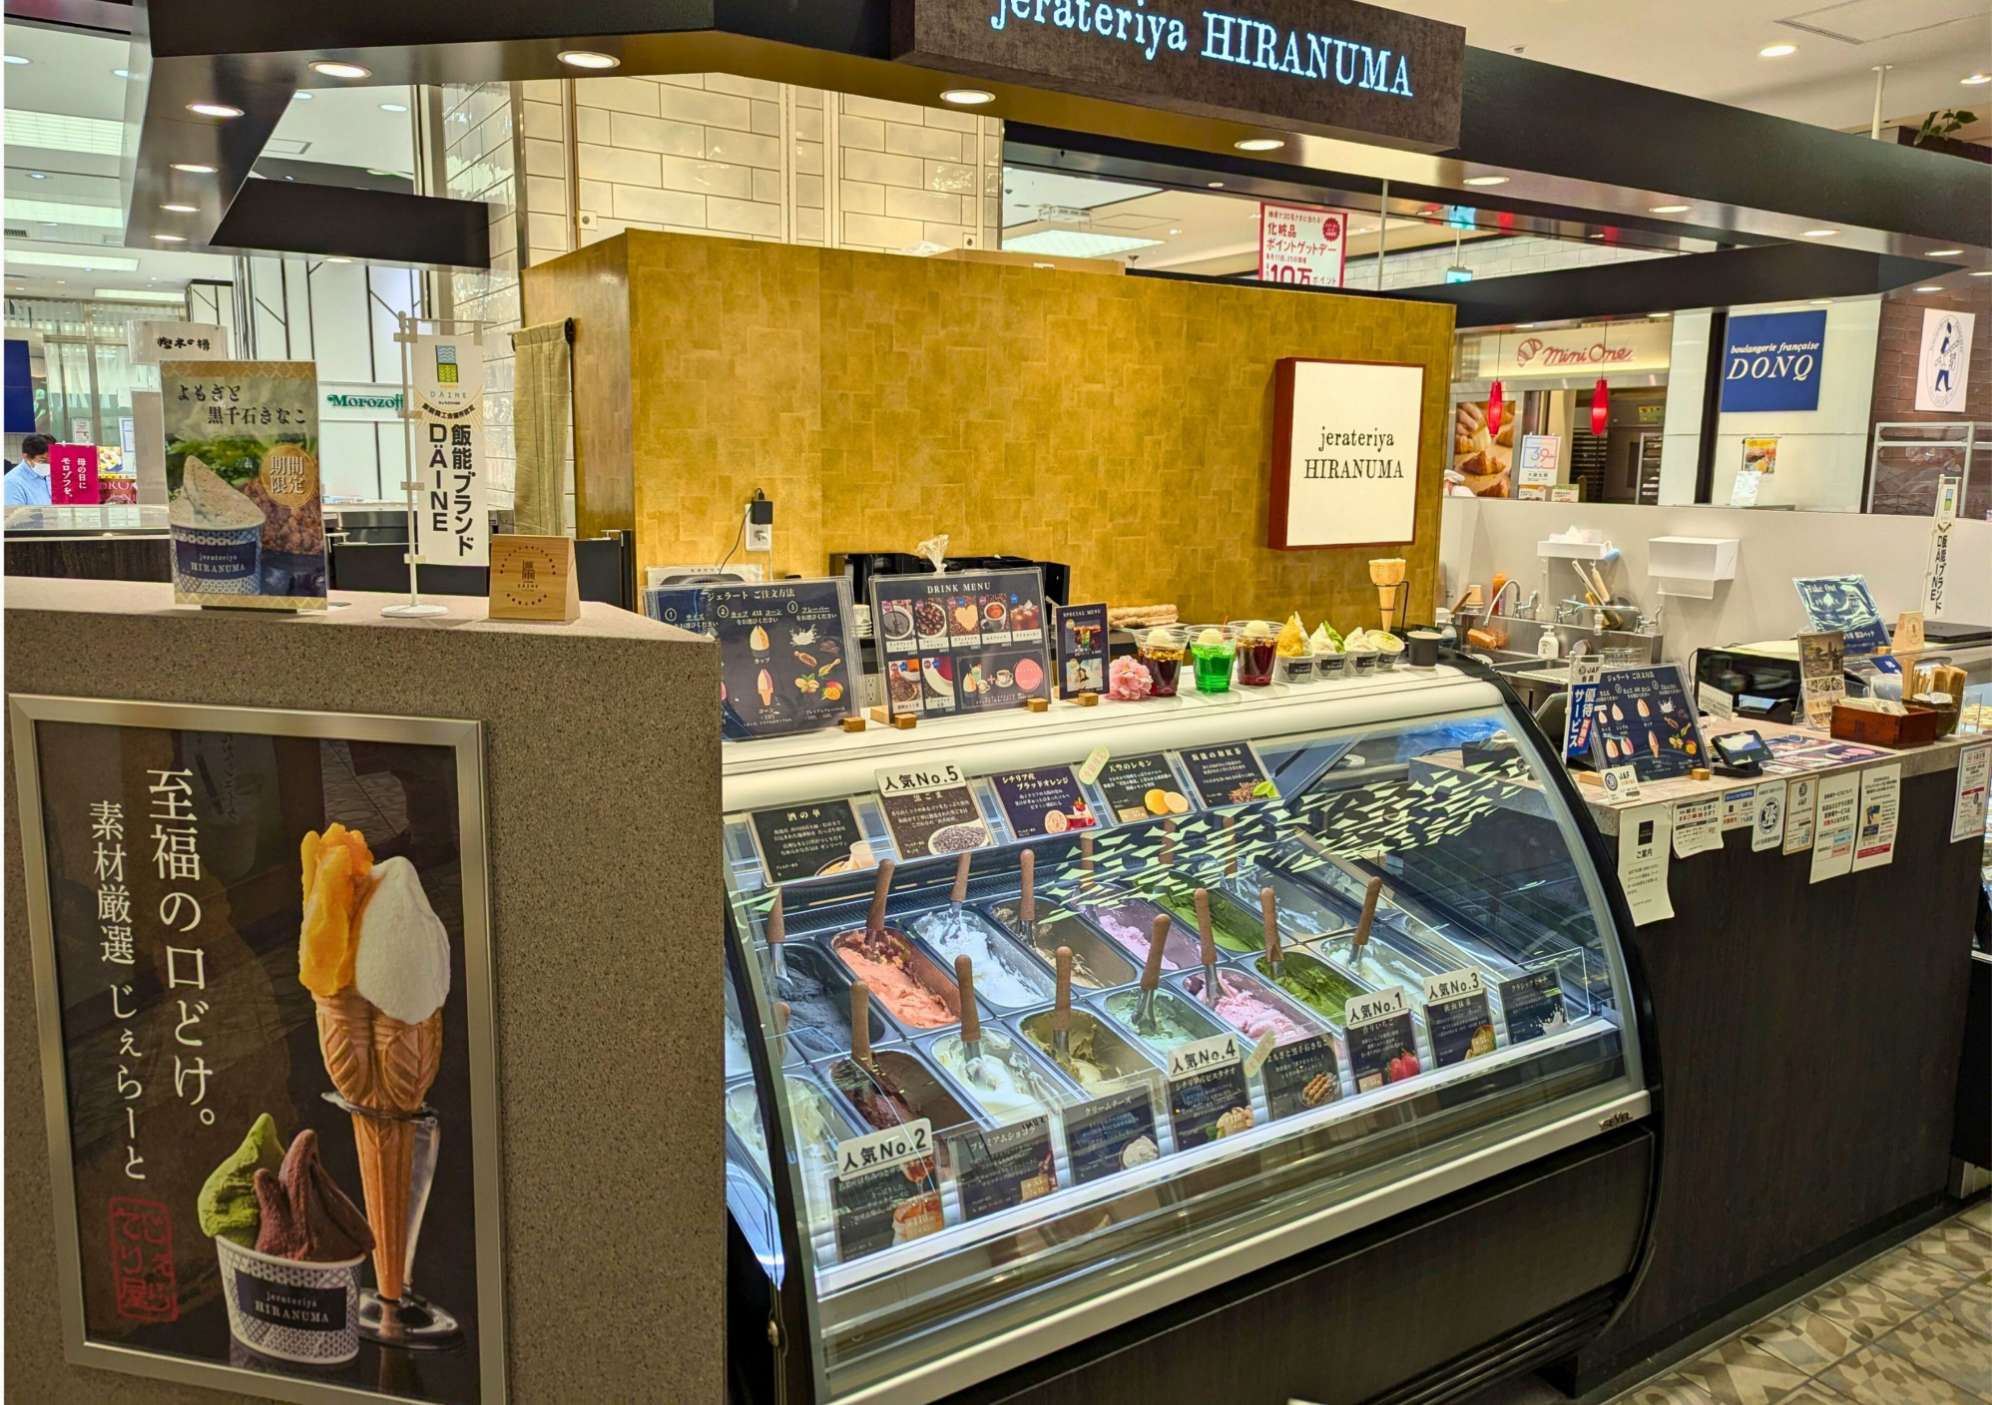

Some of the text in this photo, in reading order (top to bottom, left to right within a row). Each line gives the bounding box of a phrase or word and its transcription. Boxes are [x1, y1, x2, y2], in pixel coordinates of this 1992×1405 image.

[990, 0, 1413, 97] jerateriya HIRANUMA
[1268, 222, 1297, 238] 化粧品
[1266, 239, 1336, 256] ポイントゲットデー
[1730, 344, 1777, 355] boulangerie
[1727, 354, 1815, 381] DONQ
[178, 384, 241, 401] よもぎと
[207, 406, 307, 425] 黒千石きなこ
[1318, 426, 1395, 452] jerateriya
[61, 457, 73, 498] モロゾフを、
[77, 458, 87, 489] 母の日に
[270, 455, 305, 476] 期間
[429, 423, 448, 532] DÄINE
[1304, 458, 1404, 479] HIRANUMA
[271, 477, 305, 495] 限定
[451, 423, 476, 556] 飯能ブランド
[190, 562, 245, 574] HIRANUMA
[705, 591, 748, 601] ジェラート
[927, 582, 991, 594] DRINK MENU
[1569, 689, 1585, 749] サービス
[885, 765, 959, 791] 人気No.5
[146, 767, 215, 1127] 至福の口どけ。
[89, 799, 148, 1182] 素材厳選 じぇらーと
[1429, 972, 1480, 1000] 人気No.3
[1350, 991, 1403, 1023] 人気No.1
[1172, 1038, 1236, 1074] 人気No.4
[843, 1127, 927, 1173] 人気No.2
[254, 1301, 331, 1324] HIRANUMA
